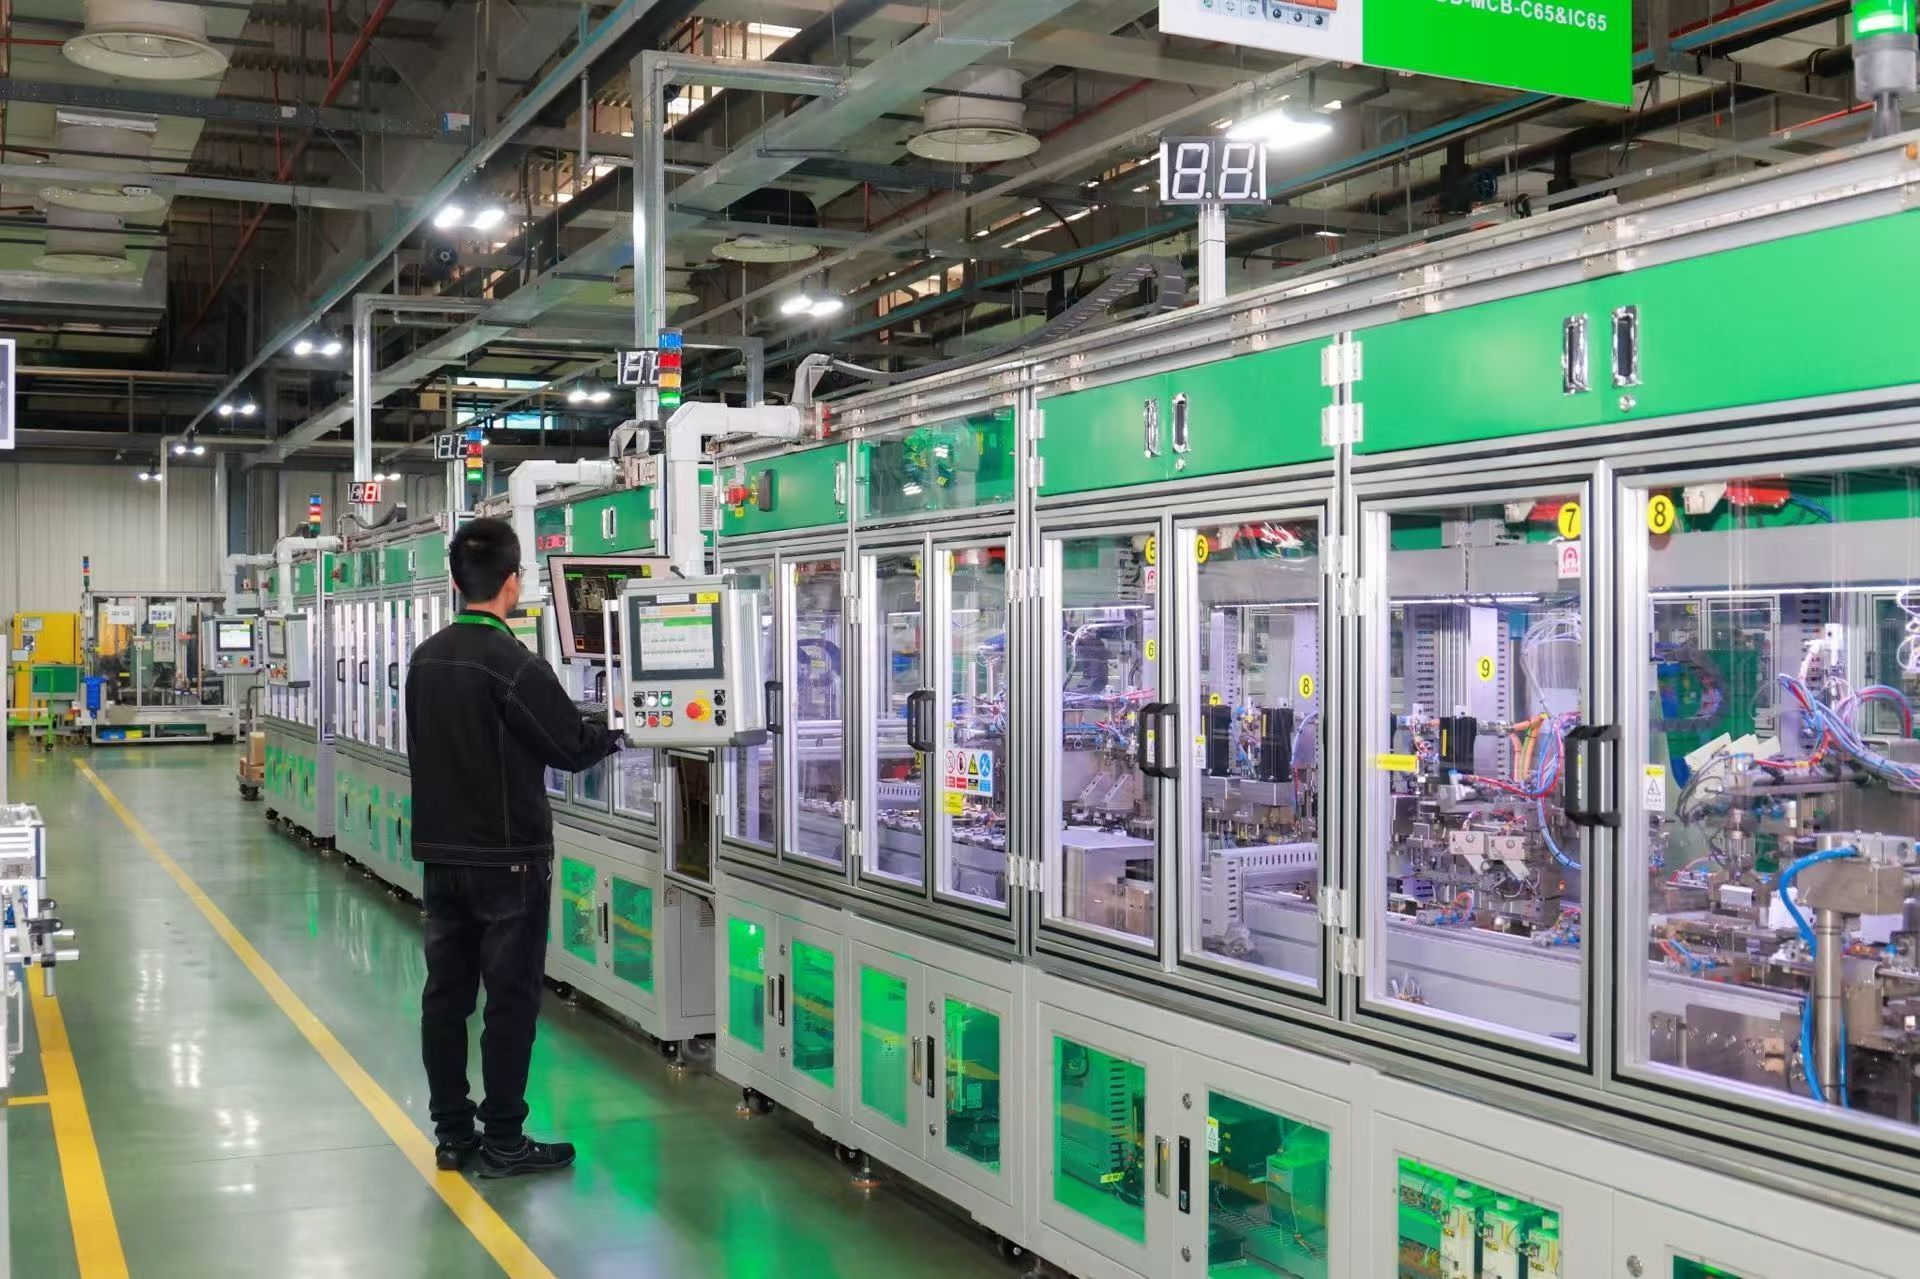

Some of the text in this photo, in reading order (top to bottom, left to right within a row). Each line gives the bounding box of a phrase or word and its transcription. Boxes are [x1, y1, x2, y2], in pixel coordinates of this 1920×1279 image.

[1565, 507, 1577, 533] 7
[1654, 501, 1666, 527] 8
[1197, 538, 1205, 558] 6
[1148, 641, 1154, 657] 6
[1481, 658, 1490, 678] 9
[1303, 677, 1310, 695] 8
